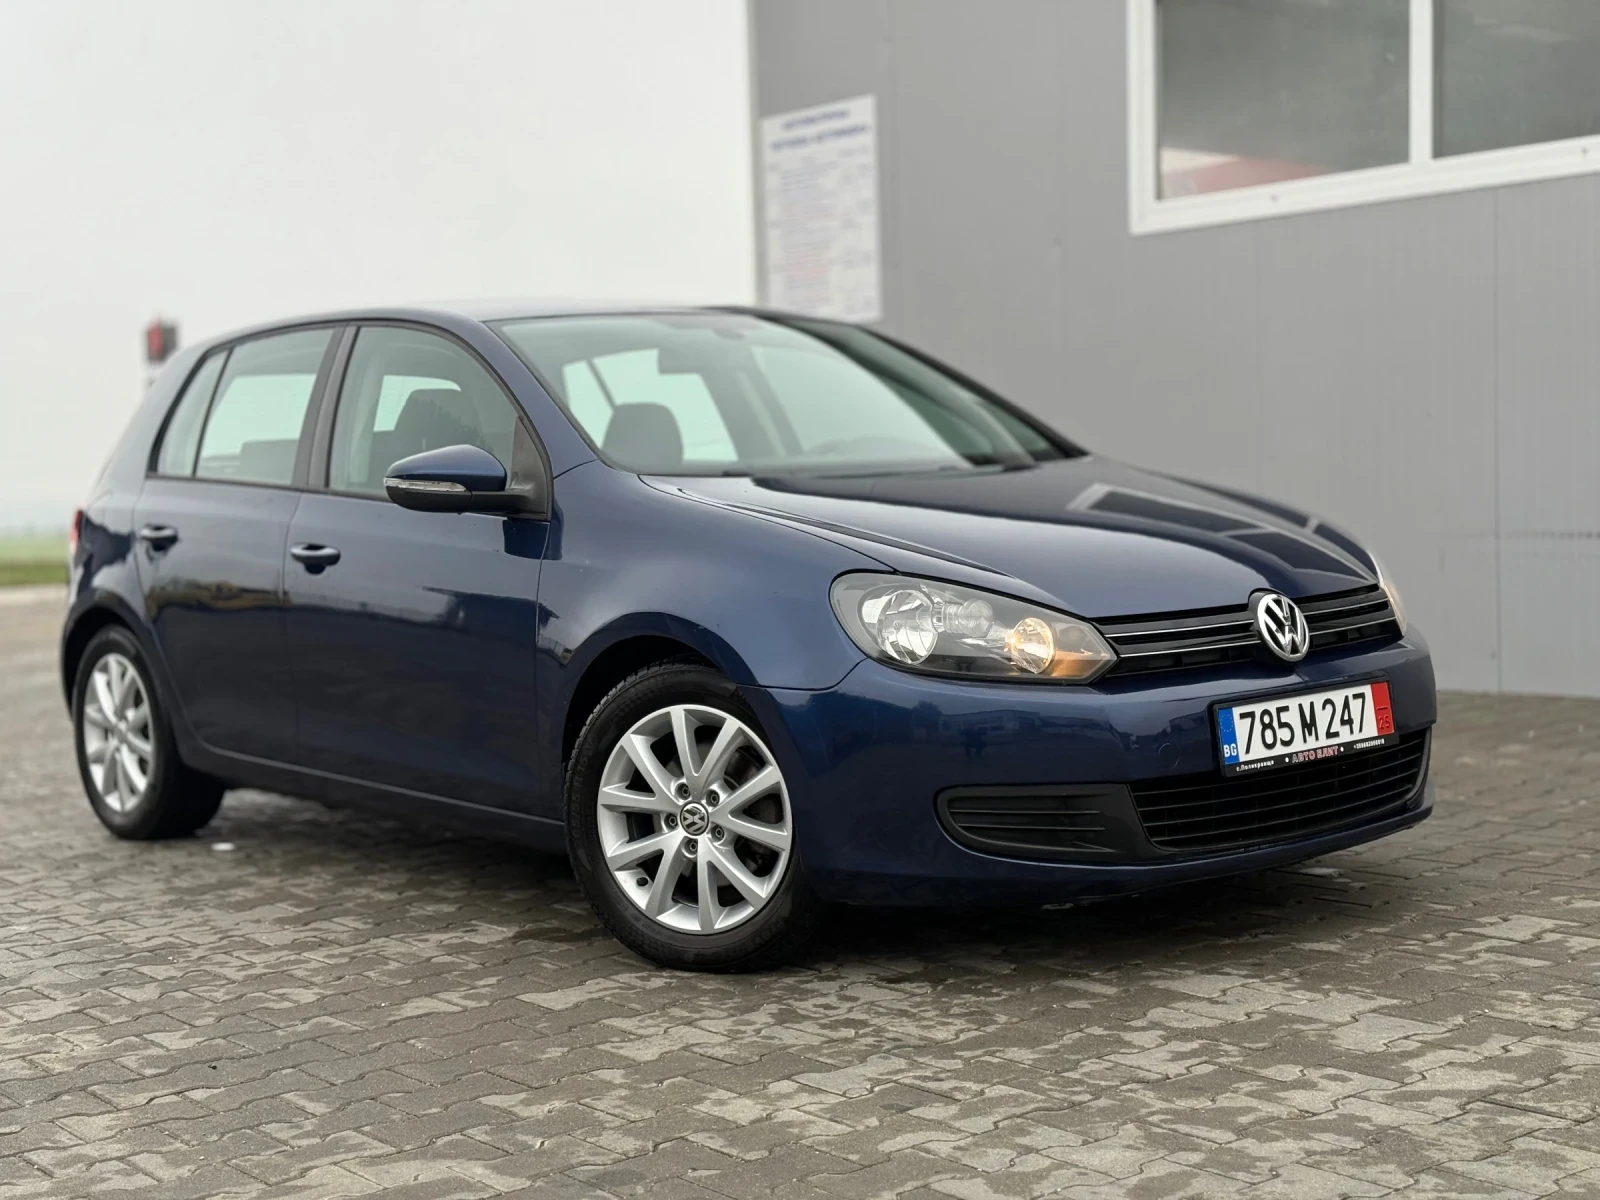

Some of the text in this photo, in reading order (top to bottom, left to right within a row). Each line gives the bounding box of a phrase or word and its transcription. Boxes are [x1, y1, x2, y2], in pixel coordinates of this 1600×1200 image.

[1239, 692, 1366, 755] 785 M 247
[1223, 743, 1238, 758] BG
